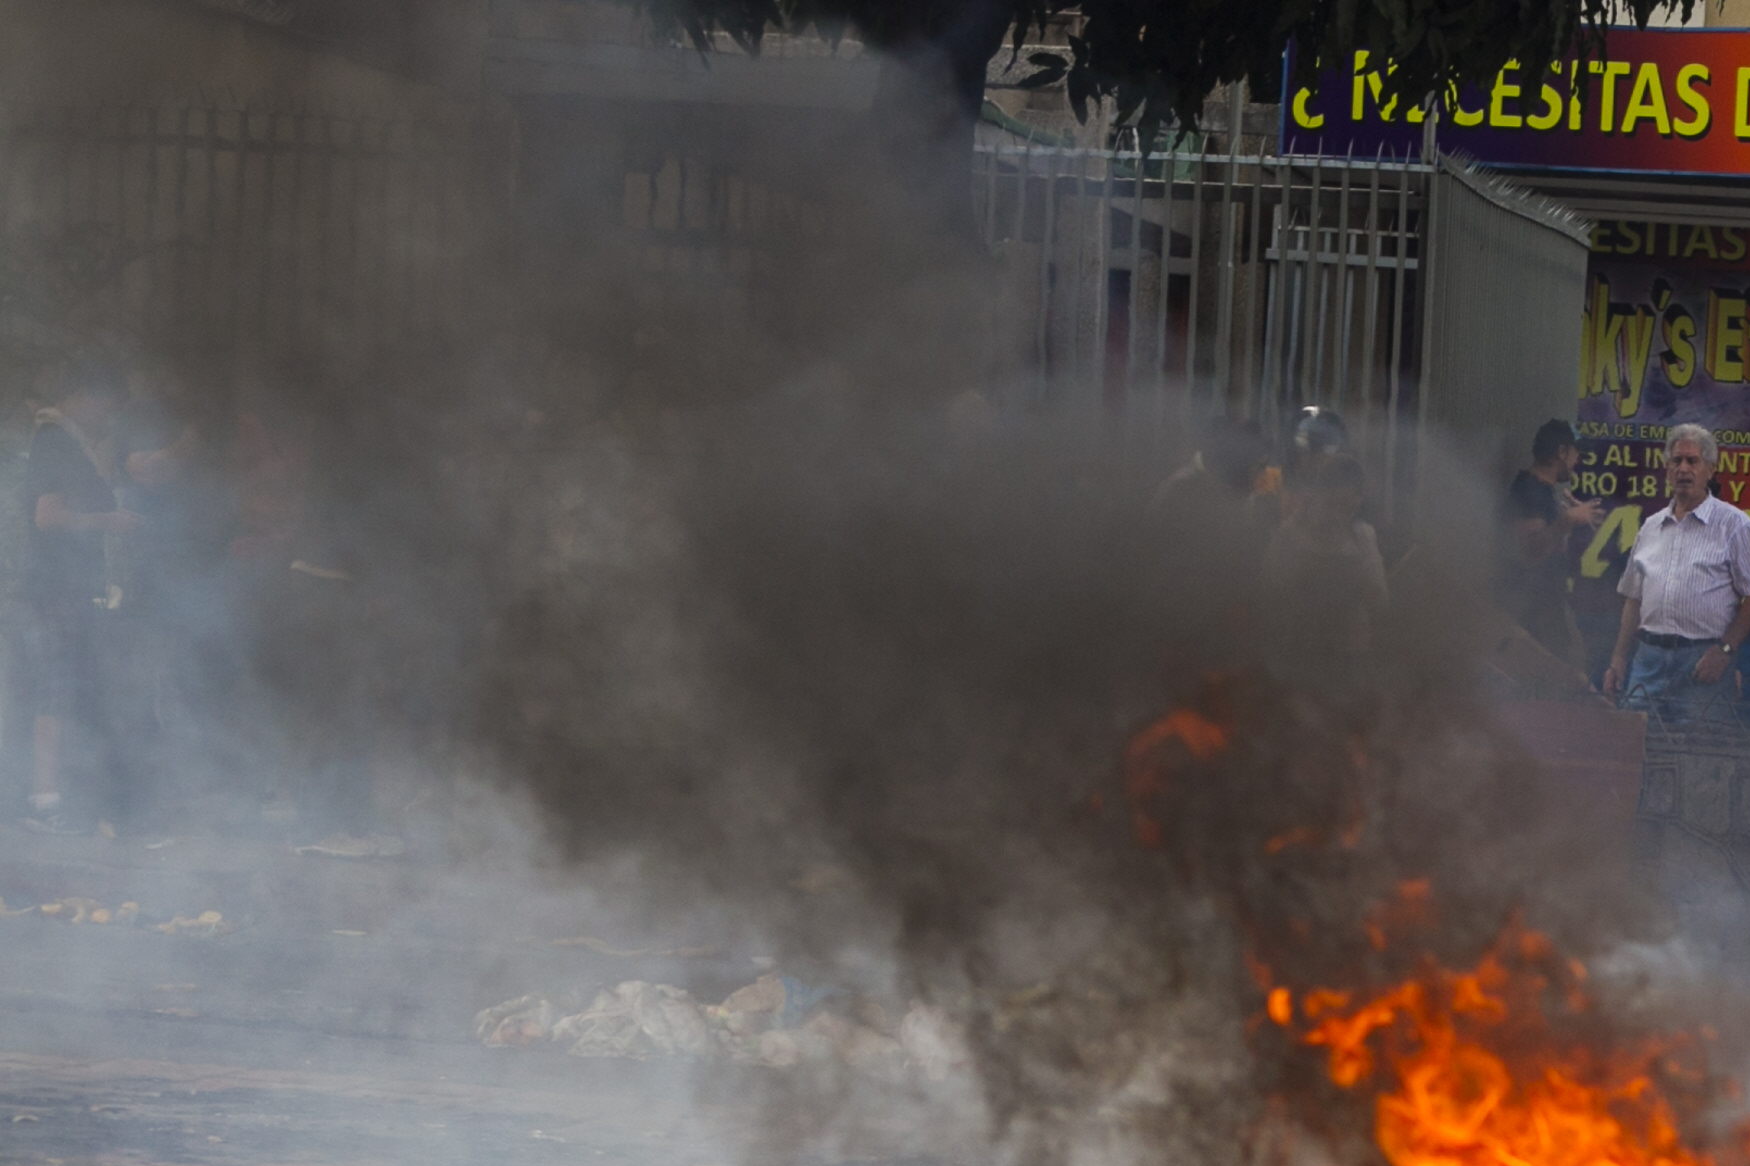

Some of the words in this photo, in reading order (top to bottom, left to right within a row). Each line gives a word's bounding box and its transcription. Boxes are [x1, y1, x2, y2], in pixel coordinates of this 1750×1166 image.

[1352, 50, 1712, 137] NCESITAS
[1577, 421, 1609, 438] ASA
[1614, 423, 1634, 438] DE
[1603, 443, 1639, 468] AL
[1626, 475, 1658, 499] 18
[1728, 480, 1746, 502] Y
